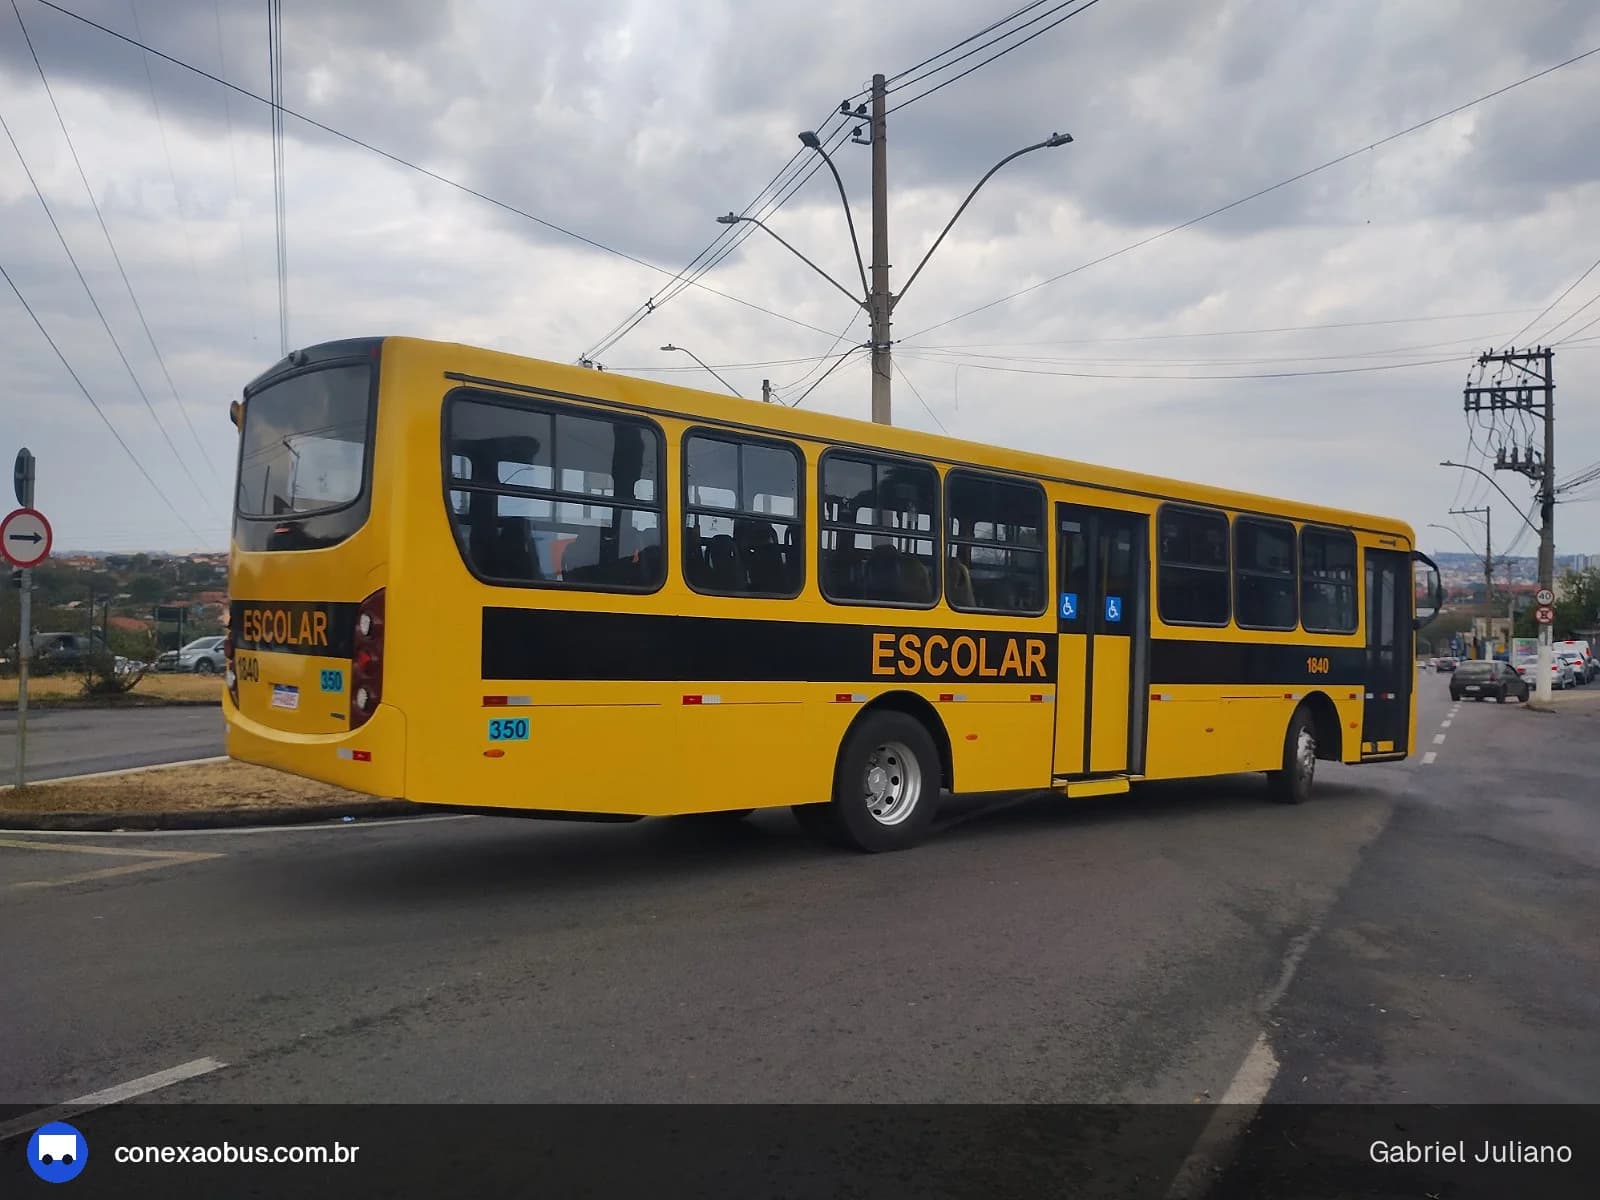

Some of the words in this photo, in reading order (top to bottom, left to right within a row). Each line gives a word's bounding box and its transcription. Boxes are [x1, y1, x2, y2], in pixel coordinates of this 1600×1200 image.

[243, 609, 328, 647] ESCOLAR
[872, 633, 1047, 677] ESCOLAR
[1307, 657, 1329, 674] 1840
[238, 656, 259, 683] 1840
[321, 671, 343, 690] 350
[490, 719, 527, 740] 350
